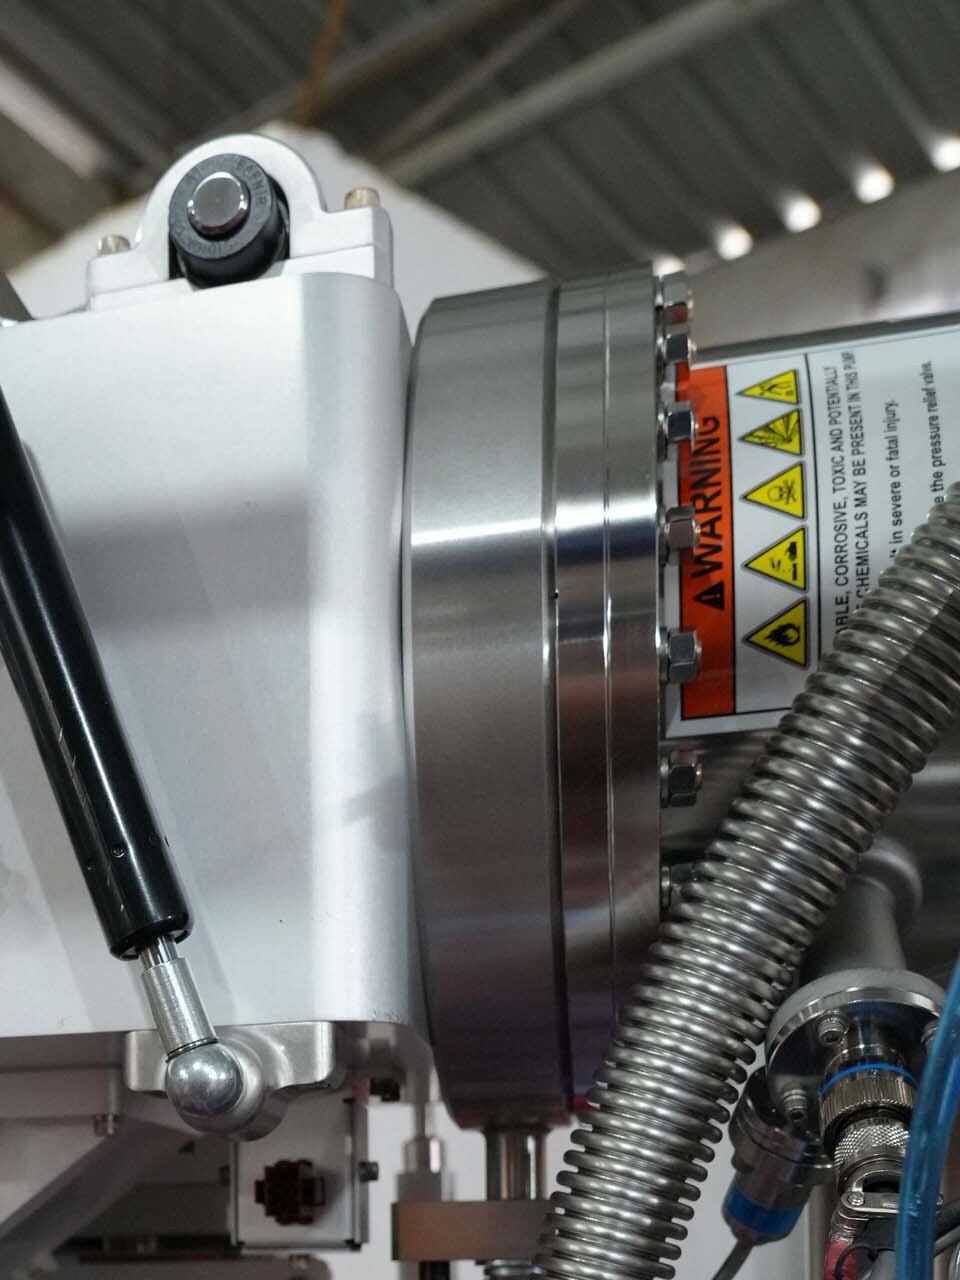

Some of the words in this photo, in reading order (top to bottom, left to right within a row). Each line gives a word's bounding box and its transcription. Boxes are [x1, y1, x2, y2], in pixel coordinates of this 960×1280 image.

[845, 371, 859, 391] THIS
[847, 392, 861, 403] IN
[921, 386, 939, 413] relief
[829, 428, 844, 452] AND
[848, 404, 865, 456] PRESENT
[927, 415, 945, 470] pressure
[884, 435, 900, 461] fatal
[831, 455, 846, 494] TOXIC
[851, 458, 867, 477] BE
[889, 465, 901, 478] or
[853, 480, 868, 508] MAY
[930, 471, 946, 493] the
[691, 416, 723, 578] WARNING
[890, 480, 903, 526] severe
[833, 496, 849, 586] CORROSIVE,
[889, 530, 903, 545] in
